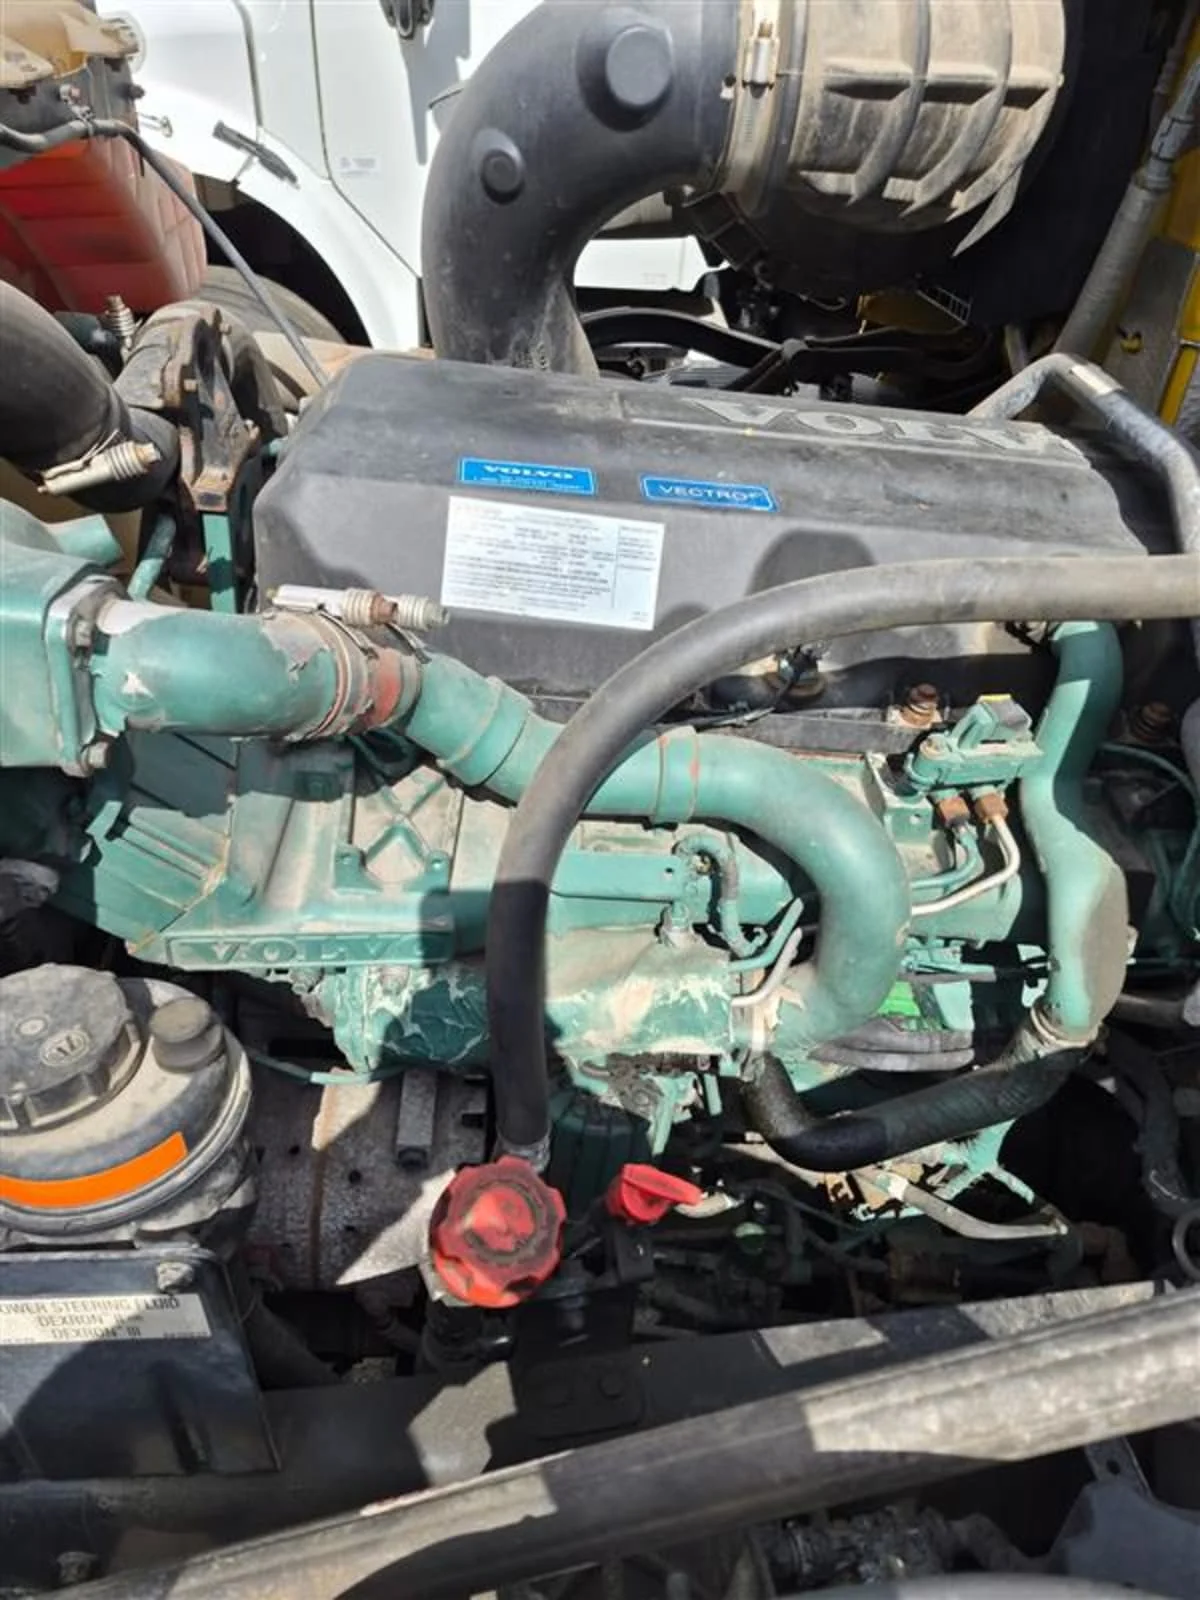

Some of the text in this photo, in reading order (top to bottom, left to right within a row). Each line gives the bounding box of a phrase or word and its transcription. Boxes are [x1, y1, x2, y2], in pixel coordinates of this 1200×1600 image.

[691, 396, 1046, 452] VOLV
[483, 464, 574, 481] VOLVO
[0, 1301, 48, 1314] OWER
[52, 1299, 132, 1314] STEERING
[38, 1314, 104, 1327] DEXRON
